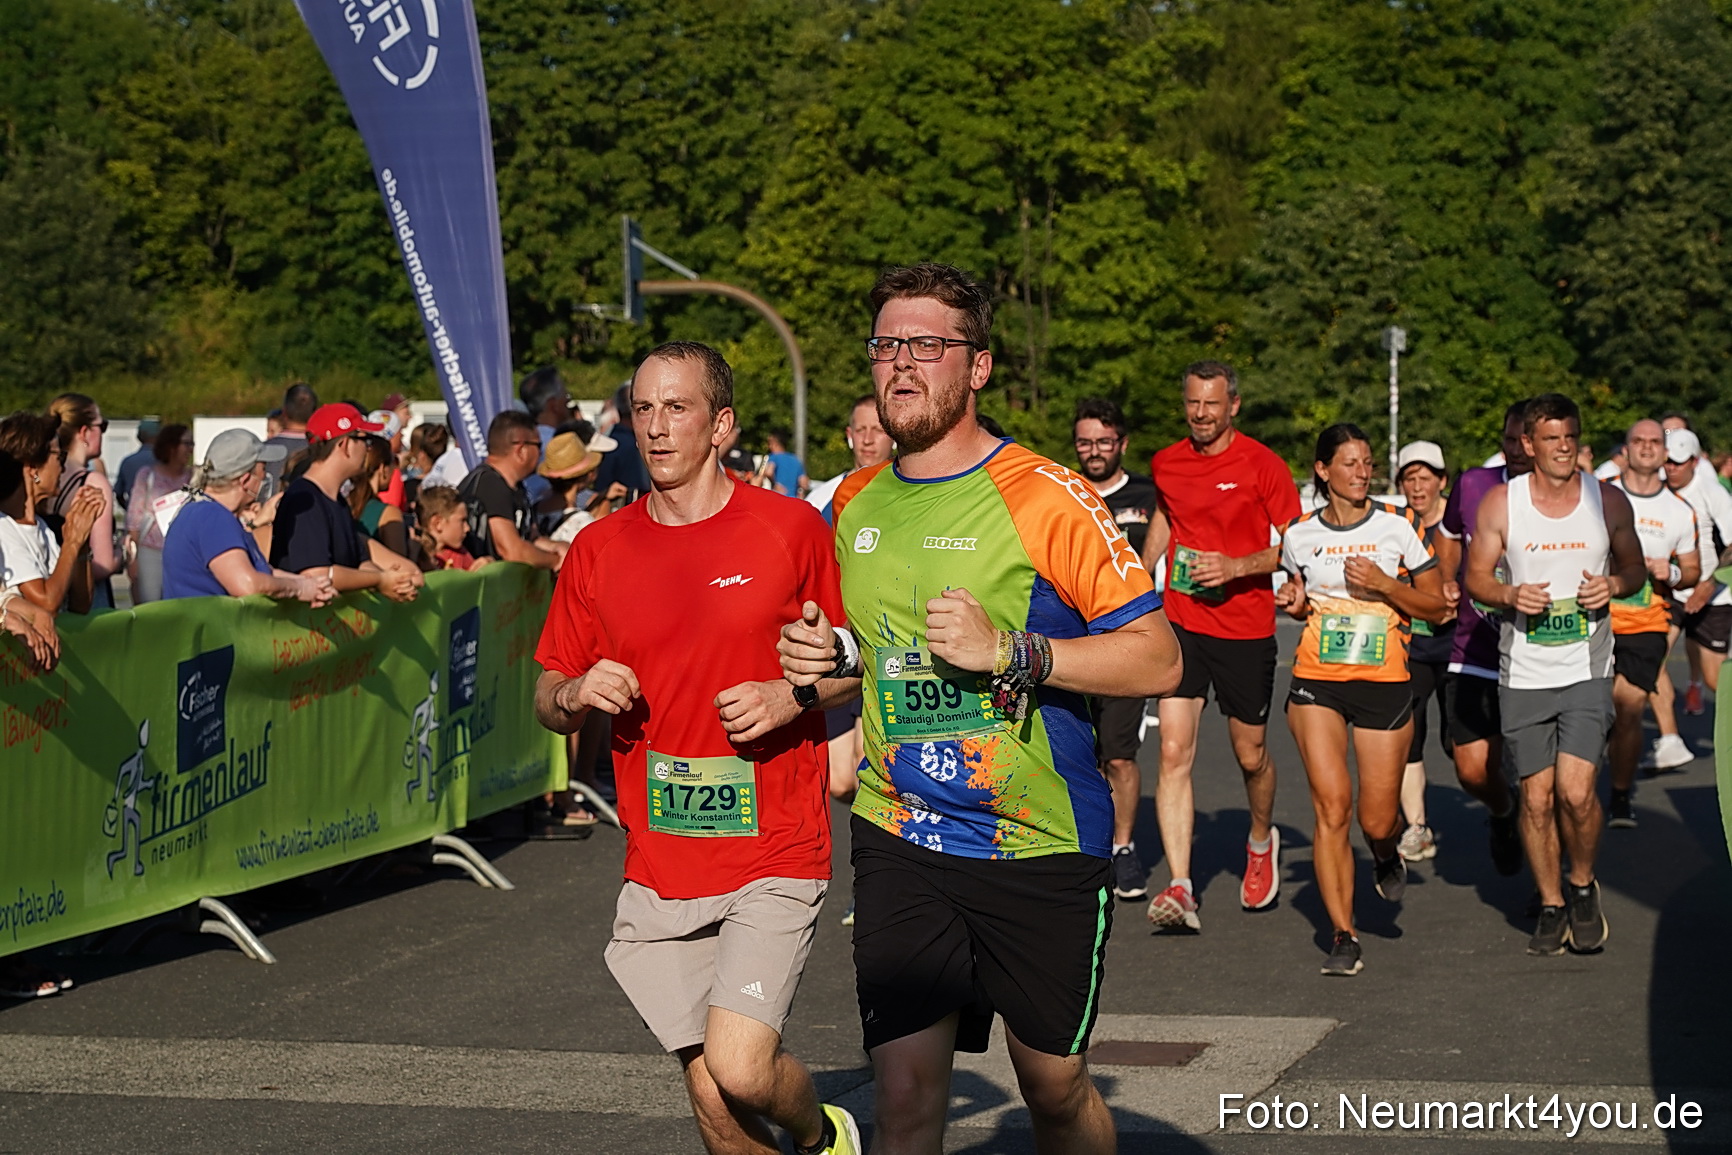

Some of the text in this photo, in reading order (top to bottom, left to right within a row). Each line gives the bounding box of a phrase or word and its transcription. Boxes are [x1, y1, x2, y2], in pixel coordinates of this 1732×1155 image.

[1034, 463, 1145, 581] BOCK
[923, 536, 978, 550] BOCK
[720, 574, 742, 588] DEHN
[1541, 613, 1574, 630] 406
[1336, 631, 1370, 648] 370
[884, 691, 896, 724] RUN
[905, 680, 962, 711] 599
[896, 708, 982, 726] Staudigl Dominik
[151, 720, 272, 838] firmenlauf
[653, 788, 662, 817] RUN
[663, 783, 737, 811] 1729
[740, 787, 752, 825] 2022
[662, 808, 742, 822] Winter Konstantin
[151, 822, 208, 866] neumarkt
[740, 987, 765, 1001] adidas
